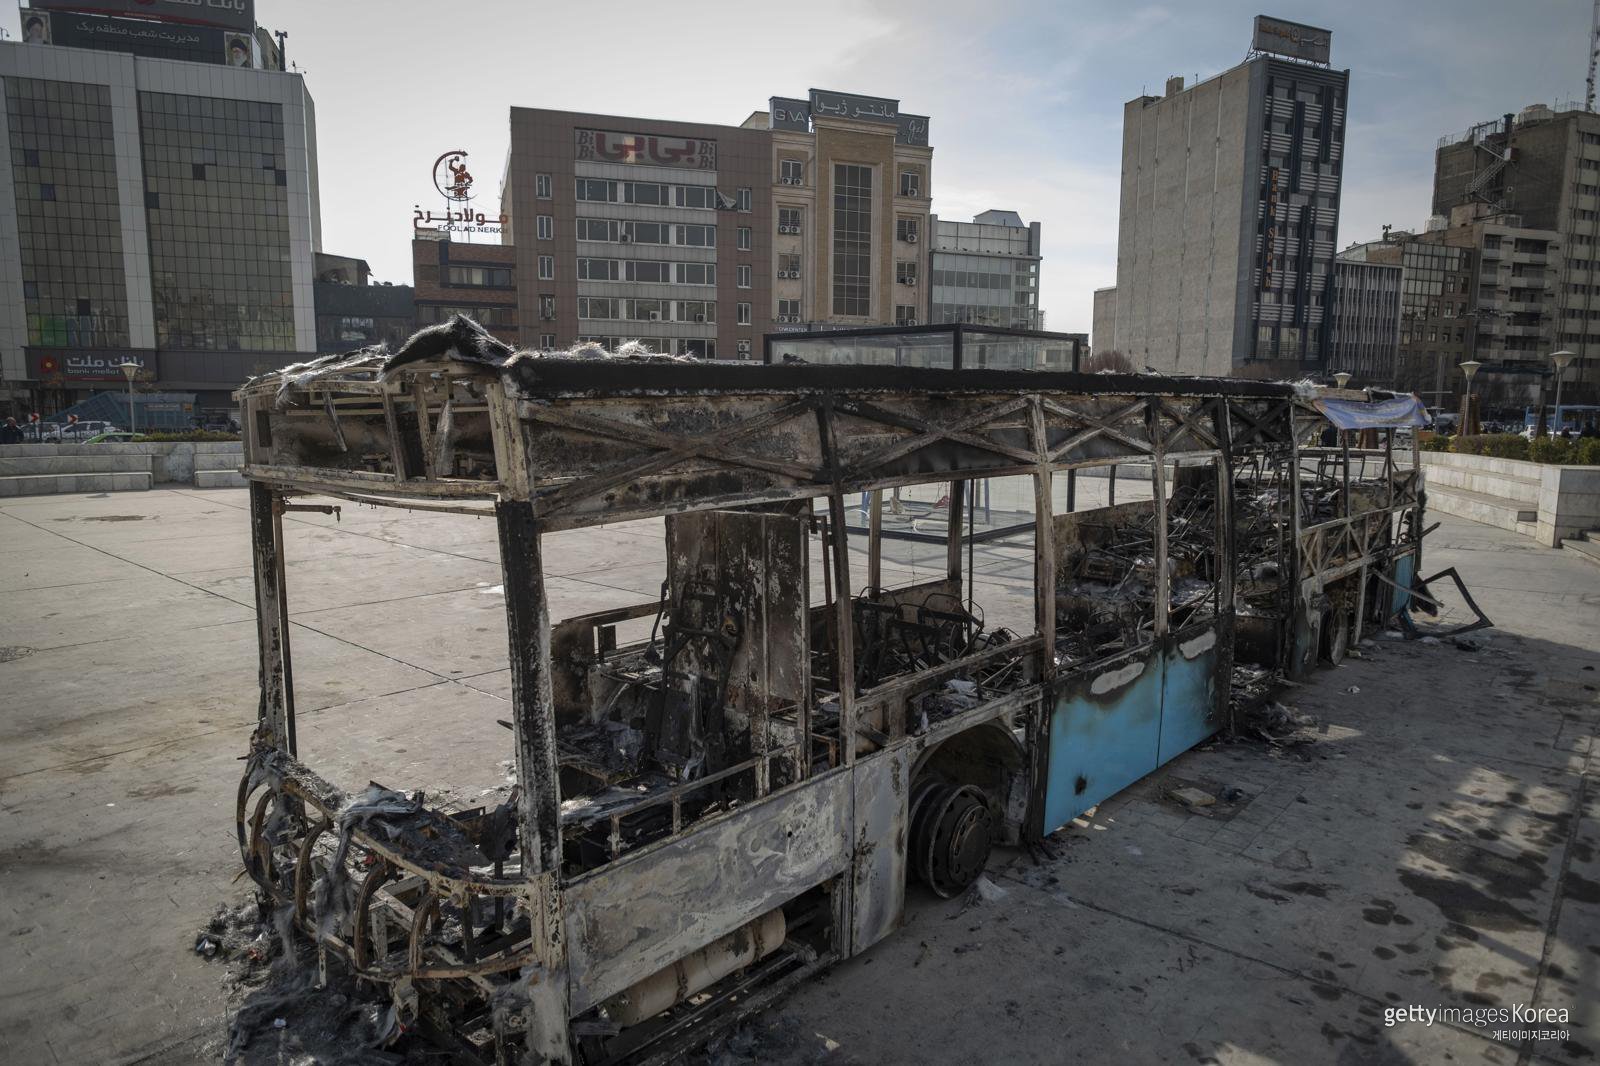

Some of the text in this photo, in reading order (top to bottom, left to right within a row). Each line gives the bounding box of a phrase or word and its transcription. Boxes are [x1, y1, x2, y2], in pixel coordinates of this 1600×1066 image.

[159, 32, 199, 43] مدیریت
[437, 224, 476, 232] FOOLAD
[66, 355, 104, 367] ملت
[92, 367, 120, 375] mellat
